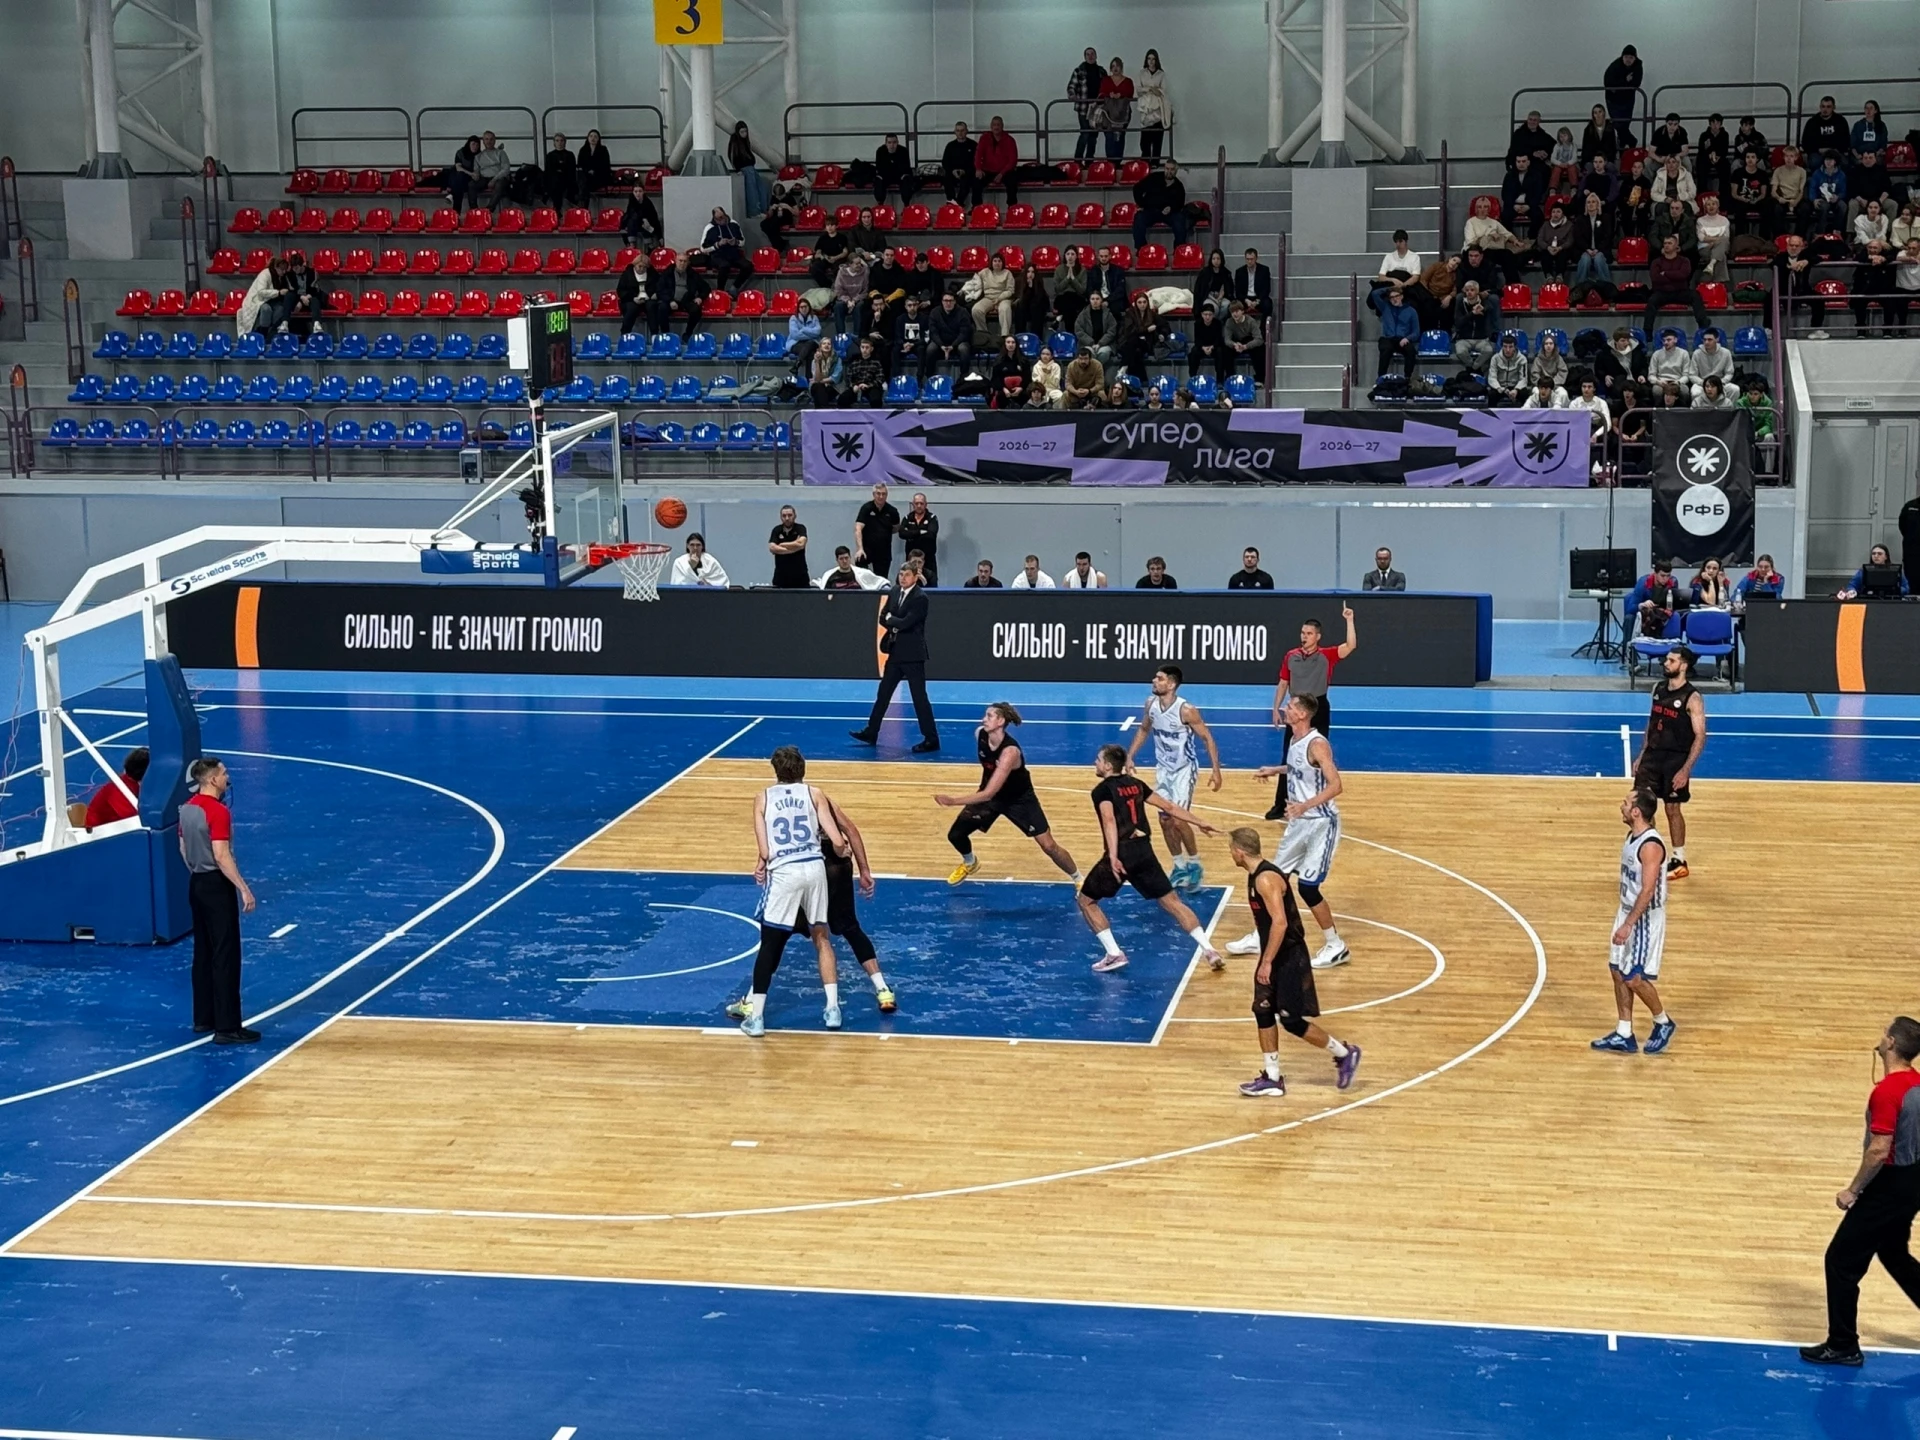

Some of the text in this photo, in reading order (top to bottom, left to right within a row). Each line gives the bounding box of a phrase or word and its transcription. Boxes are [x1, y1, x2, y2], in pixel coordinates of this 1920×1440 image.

[675, 0, 701, 35] 3
[1101, 422, 1203, 449] супер
[1193, 448, 1275, 469] лига
[1682, 504, 1725, 516] РФБ
[232, 551, 267, 569] Sports
[472, 559, 520, 570] Sports
[344, 613, 414, 649] СИЛЬНО
[432, 615, 453, 650] НЕ
[459, 615, 526, 651] ЗНАЧИТ
[531, 617, 603, 653] ГРОМКО
[992, 622, 1066, 659] СИЛЬНО
[1085, 623, 1108, 659] НЕ
[1114, 623, 1186, 660] ЗНАЧИТ
[1191, 624, 1267, 661] ГРОМКО
[1126, 798, 1138, 825] 1
[772, 815, 811, 846] 35
